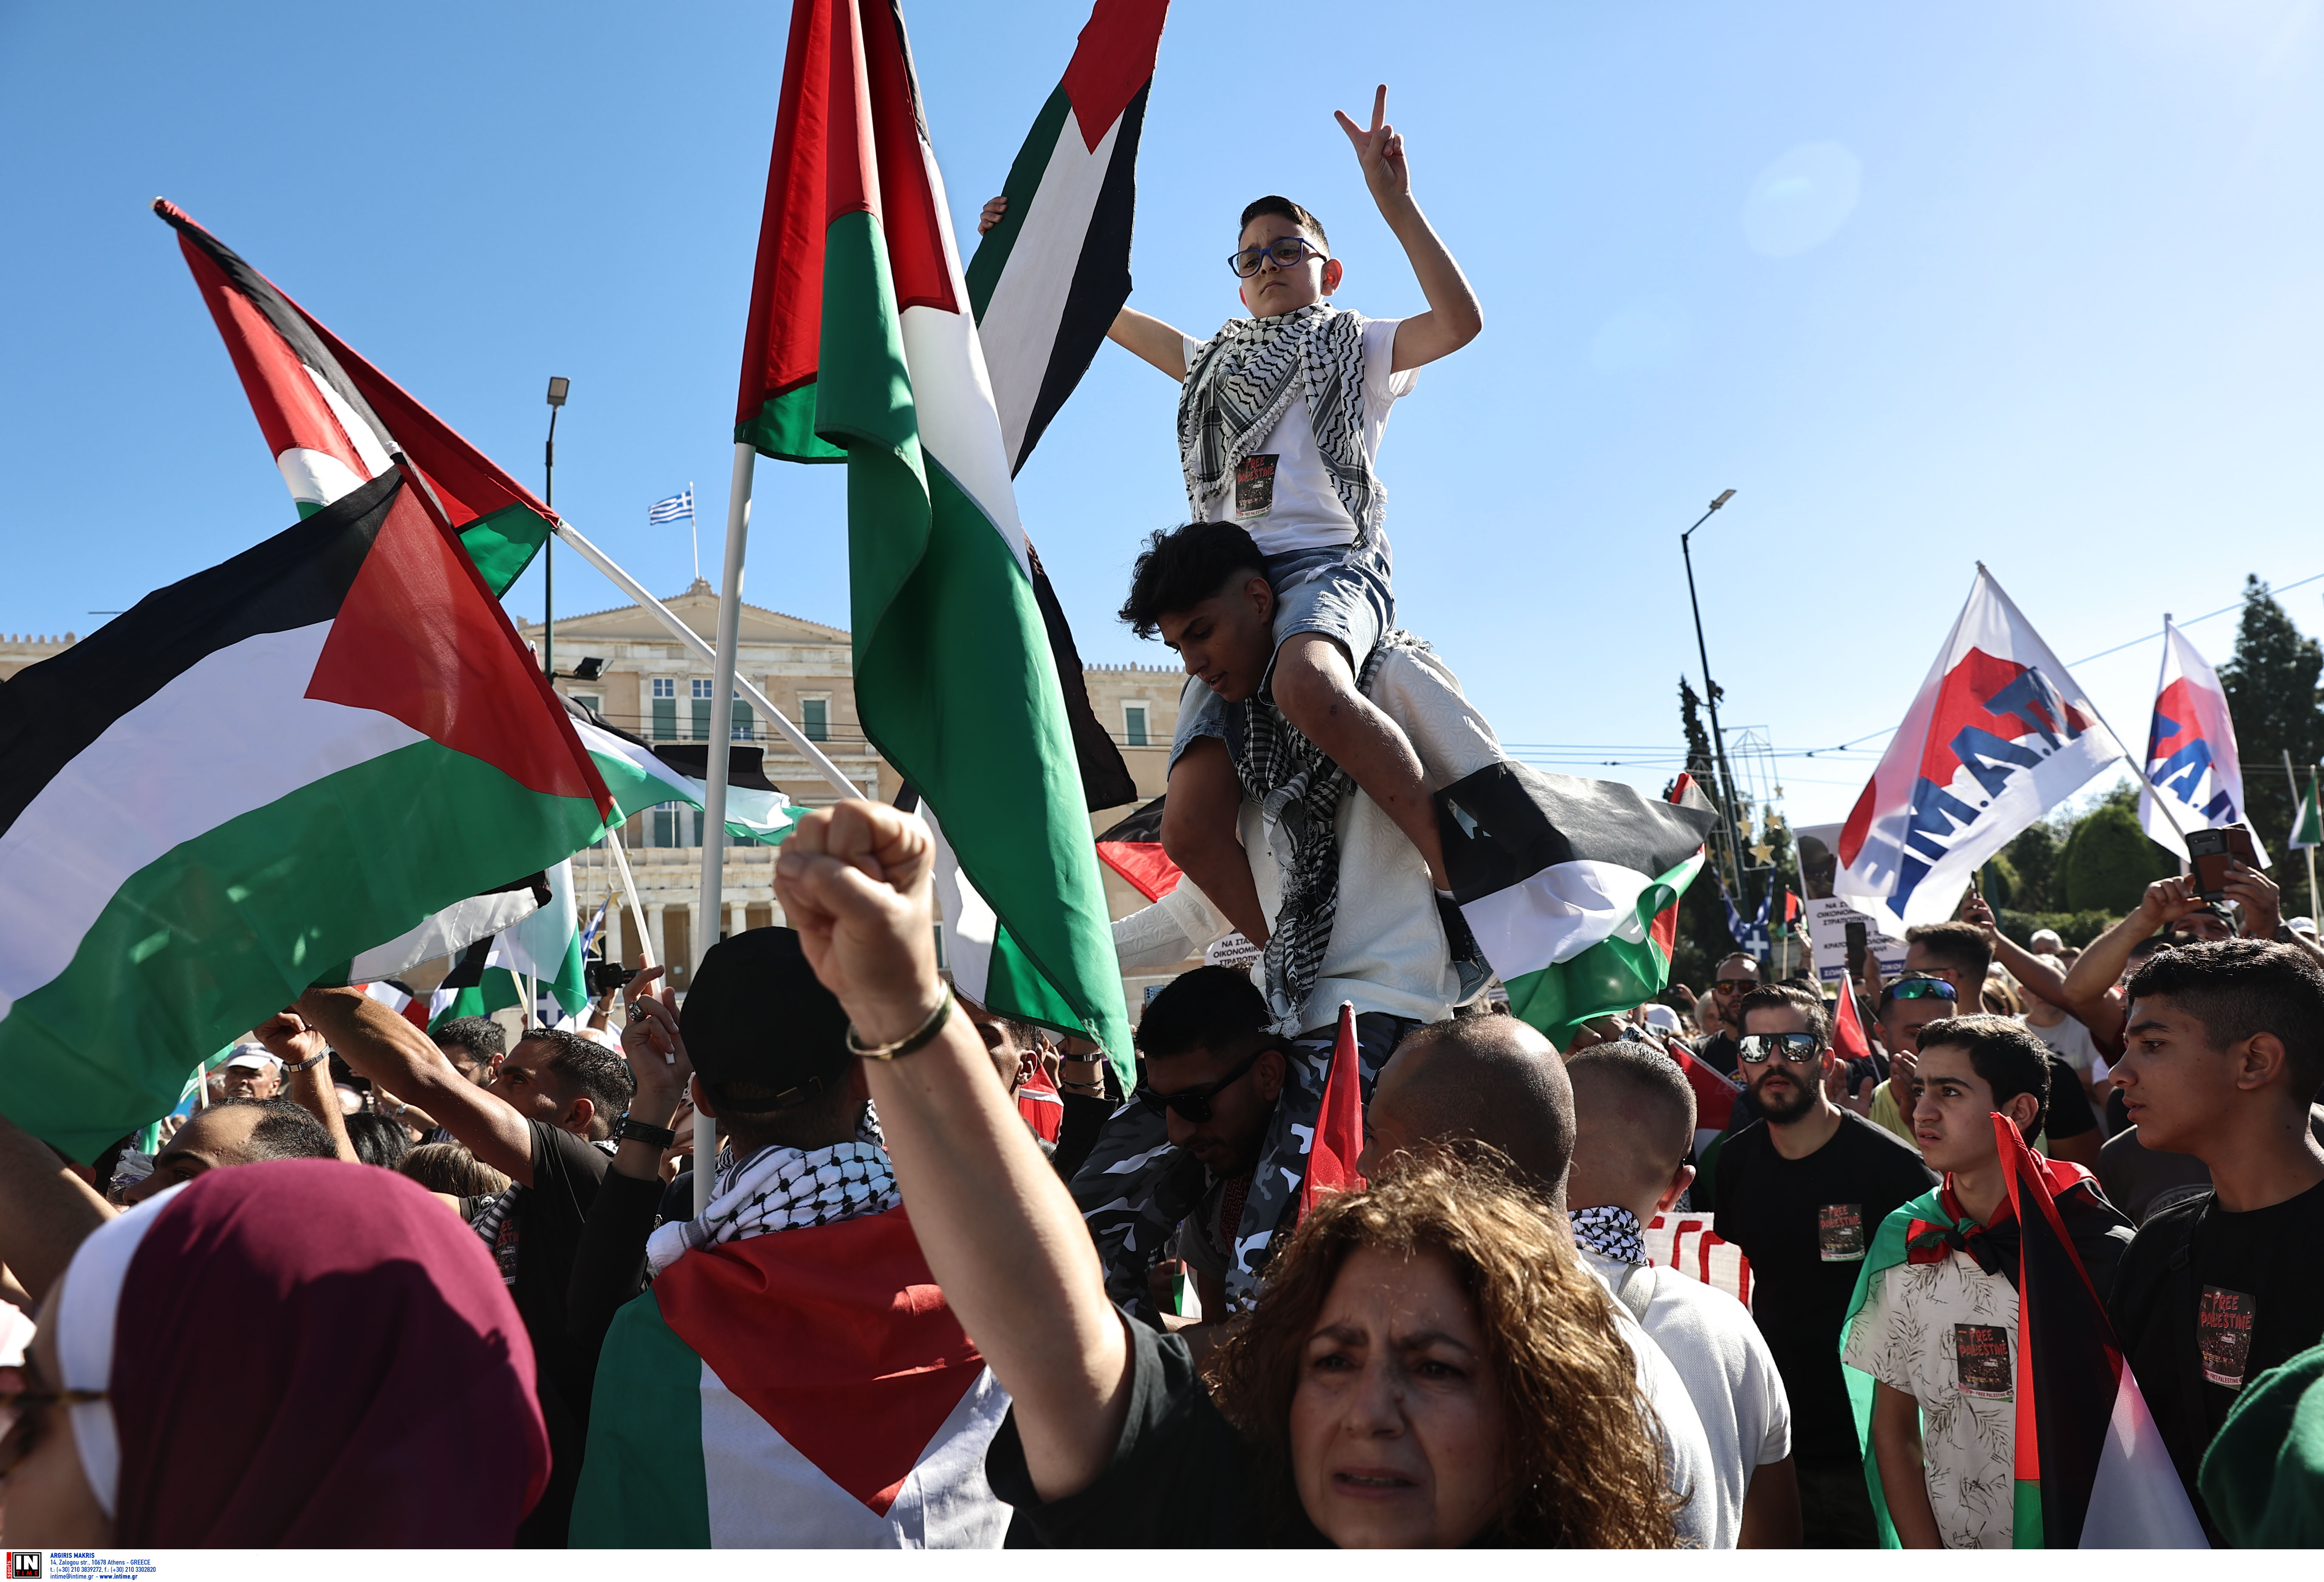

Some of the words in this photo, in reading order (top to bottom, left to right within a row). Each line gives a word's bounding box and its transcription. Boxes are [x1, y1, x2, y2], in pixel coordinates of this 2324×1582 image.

[1245, 456, 1265, 470] FREE
[1237, 465, 1275, 485] PALESTINE
[1213, 946, 1261, 958] ΟΙΚΟΝΟΜΙΚ
[2212, 1294, 2239, 1311] FREE
[2200, 1311, 2252, 1331] PALESTINE
[1969, 1328, 1994, 1343] FREE
[1958, 1342, 2008, 1357] PALESTINE
